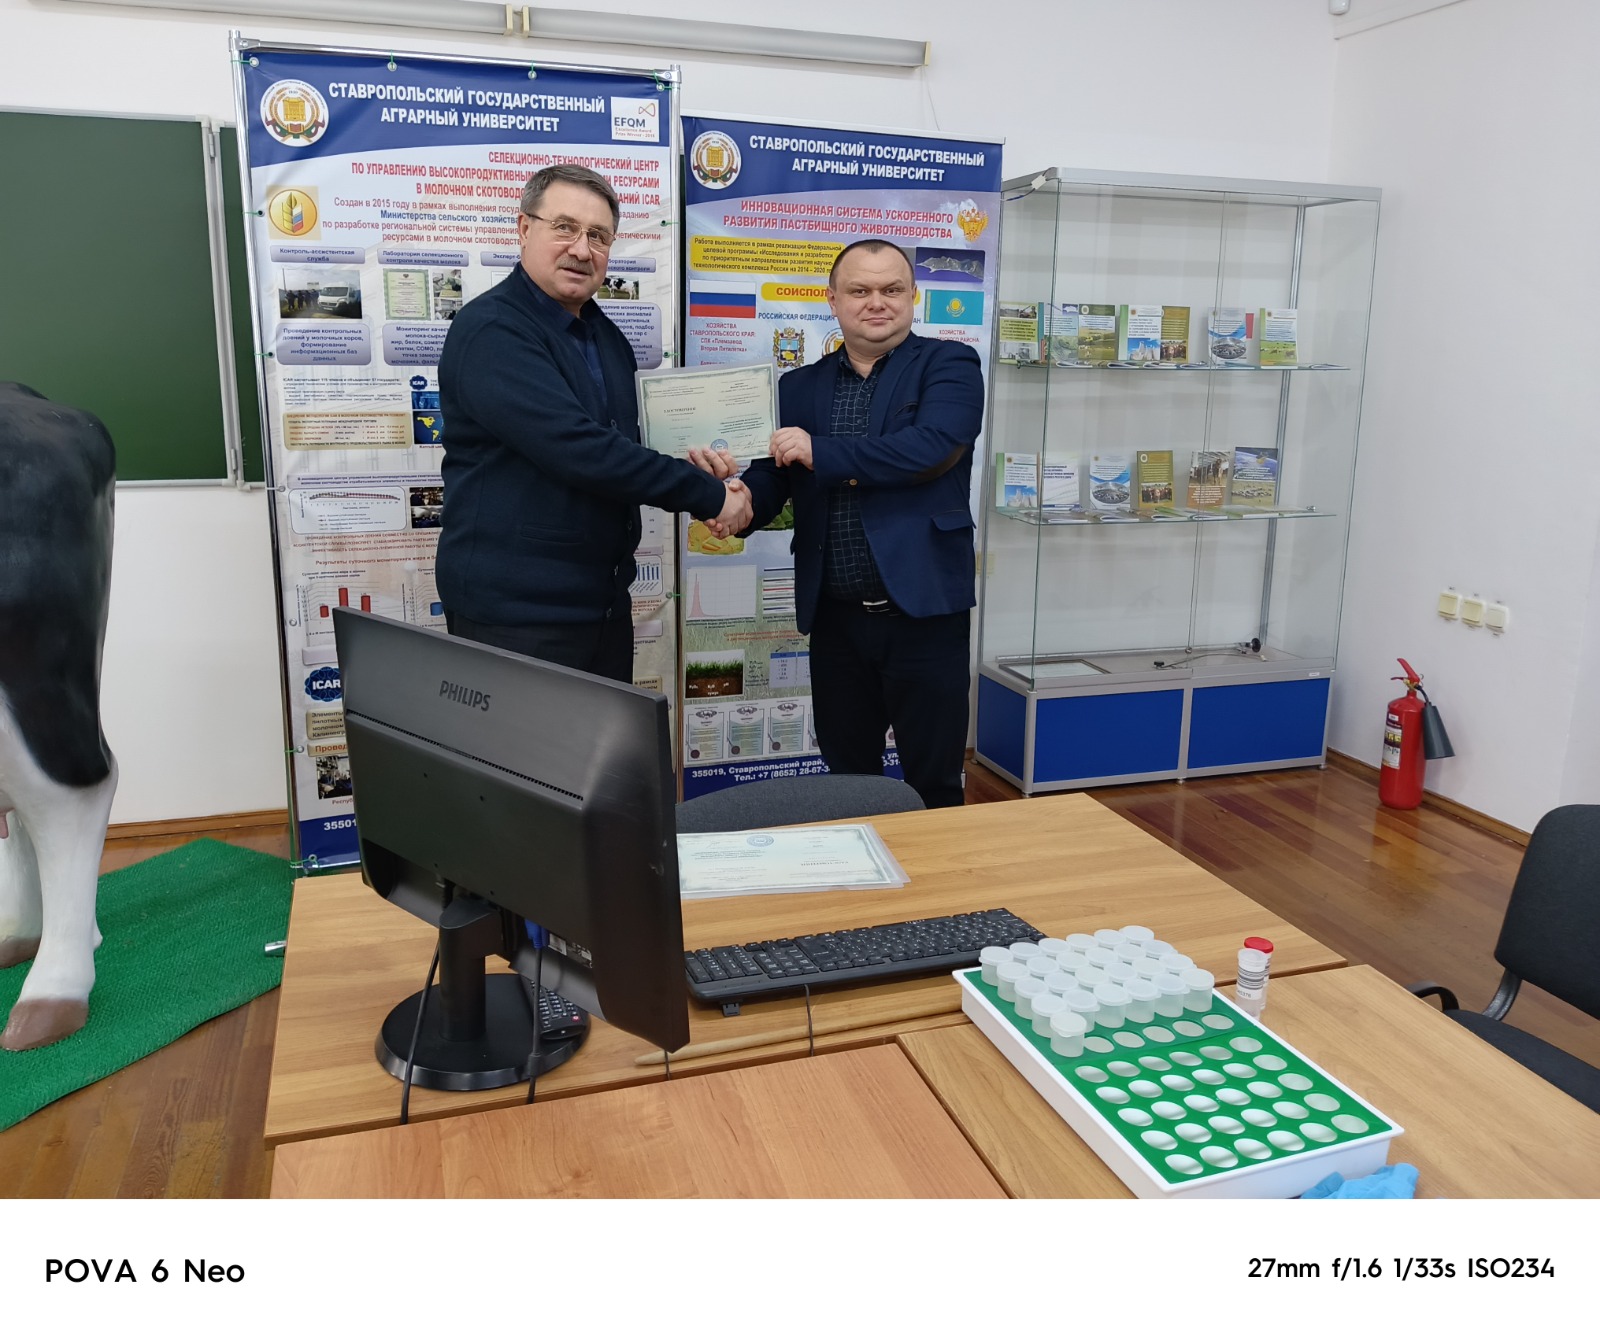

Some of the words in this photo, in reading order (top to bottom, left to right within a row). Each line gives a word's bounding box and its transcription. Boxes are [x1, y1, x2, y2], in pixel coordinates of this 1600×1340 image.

[328, 82, 464, 104] СТАВРОПОЛЬСКИЙ
[468, 90, 605, 113] ГОСУДАРСТВЕННЫЙ
[380, 107, 458, 126] АГРАРНЫЙ
[462, 113, 560, 132] УНИВЕРСИТЕТ
[614, 117, 646, 128] EFQM
[749, 135, 865, 157] СТАВРОПОЛЬСКИЙ
[868, 145, 985, 167] ГОСУДАРСТВЕННЫЙ
[352, 162, 365, 175] ПО
[367, 163, 427, 177] УПРАВЛЕНИЮ
[429, 166, 536, 182] ВЫСОКОПРОДУКТИВНЫМ
[634, 160, 660, 173] ЦЕНТР
[792, 158, 858, 175] АГРАРНЫЙ
[861, 164, 945, 182] УНИВЕРСИТЕТ
[613, 175, 660, 188] РЕСУРСАМИ
[417, 183, 422, 193] В
[424, 184, 474, 197] МОЛОЧНОМ
[334, 197, 364, 208] Создан
[372, 199, 391, 208] 2015
[392, 201, 410, 211] году
[419, 202, 446, 211] рамках
[449, 204, 497, 213] выполнения
[642, 194, 660, 205] ICAR
[380, 210, 437, 221] Министерства
[439, 213, 477, 223] сельского
[481, 214, 518, 224] хозяйства
[741, 201, 833, 218] ИННОВАЦИОННАЯ
[836, 206, 884, 220] СИСТЕМА
[885, 209, 953, 224] УСКОРЕННОГО
[335, 221, 380, 230] разработке
[381, 223, 437, 232] региональной
[475, 227, 519, 235] управления
[723, 215, 778, 229] РАЗВИТИЯ
[780, 219, 858, 235] ПАСТБИЩНОГО
[860, 223, 953, 239] ЖИВОТНОВОДСТВА
[382, 234, 425, 244] ресурсами
[434, 236, 473, 244] молочном
[475, 237, 522, 246] скотоводств
[615, 232, 661, 240] нетическими
[279, 248, 355, 256] Контроль-ассистентская
[807, 243, 842, 251] Федеральной
[776, 287, 827, 297] СОИСПОЛ
[758, 312, 799, 320] РОССИЙСКАЯ
[283, 328, 321, 336] Проведение
[690, 329, 740, 337] СТАВРОПОЛЬСКОГО
[312, 679, 341, 691] ICAR
[439, 680, 491, 712] PHILIPS
[312, 730, 346, 738] Калинингр
[692, 767, 727, 778] 355019,
[728, 761, 800, 775] Ставропольский
[801, 759, 825, 768] край,
[770, 769, 797, 780] (8652)
[799, 765, 830, 775] 28-67-3
